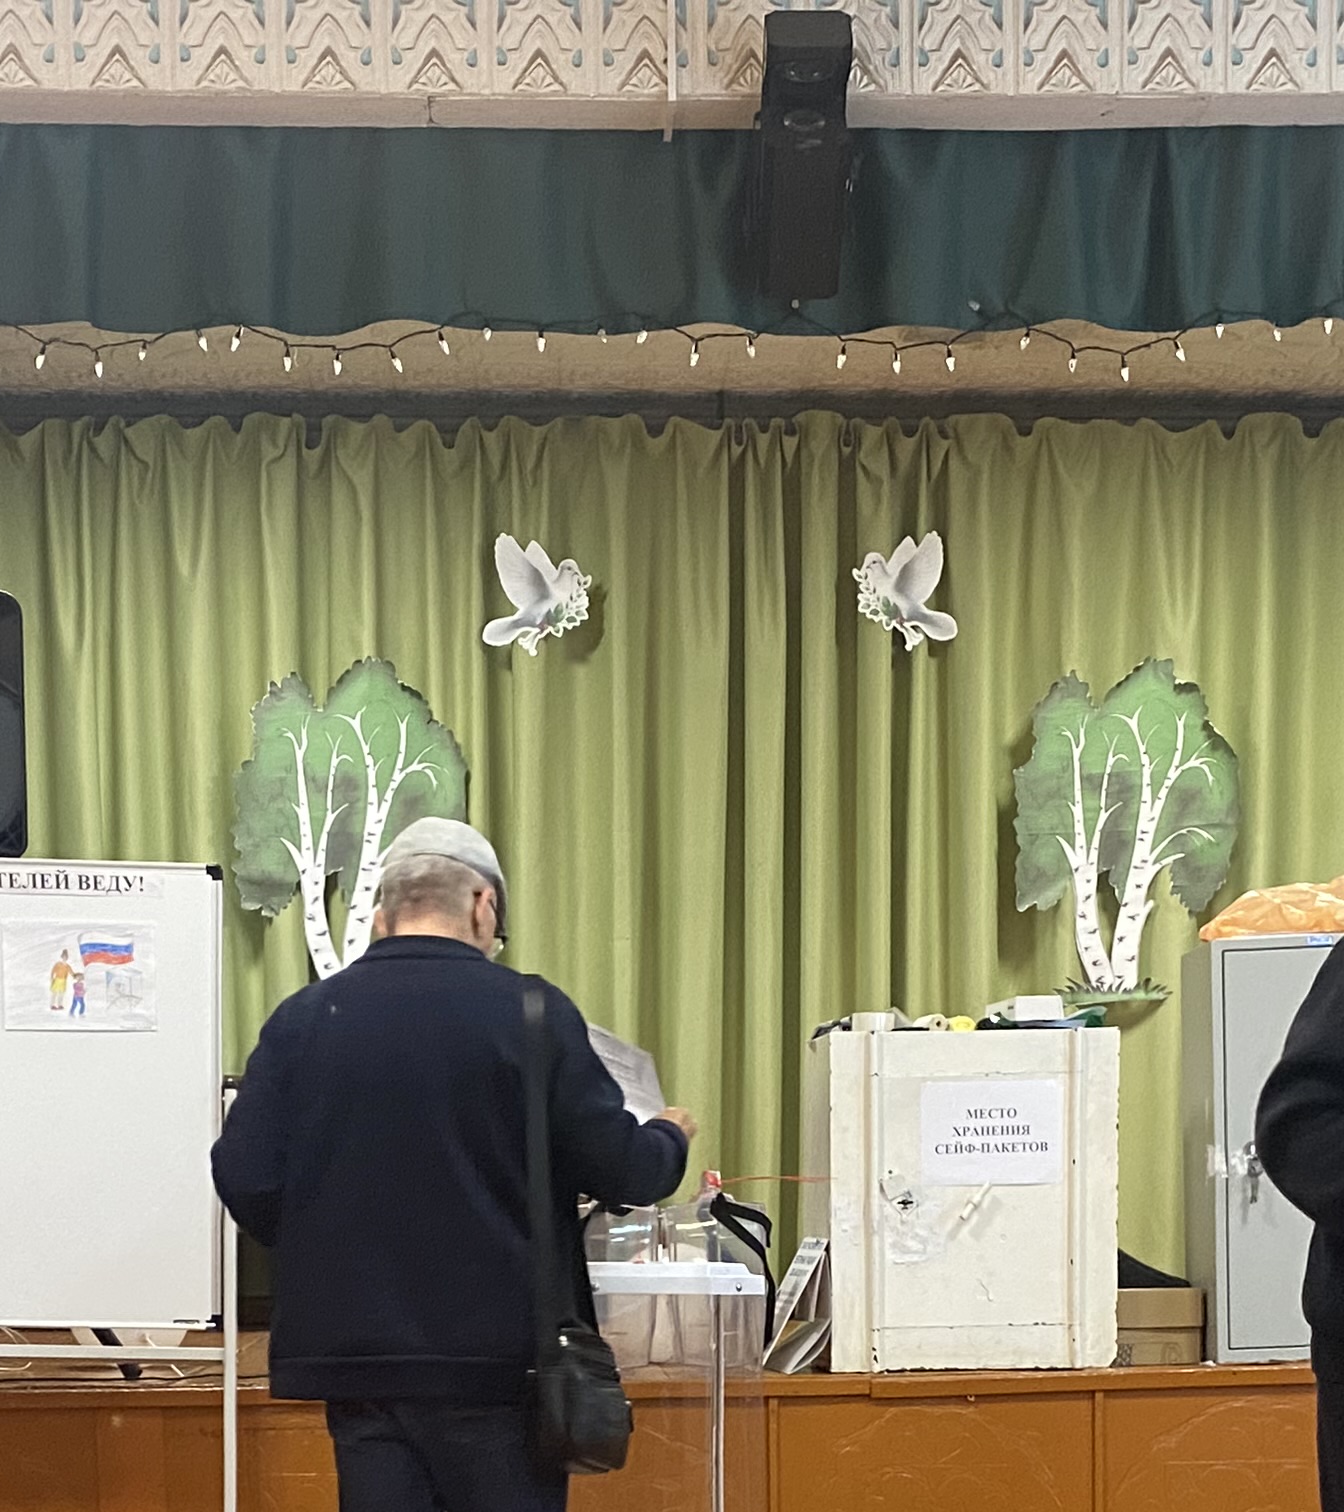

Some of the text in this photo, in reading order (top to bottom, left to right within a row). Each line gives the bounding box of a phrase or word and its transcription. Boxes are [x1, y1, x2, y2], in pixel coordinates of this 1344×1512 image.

[78, 874, 144, 894] ВЕДУ!
[966, 1108, 1017, 1119] МЕСТО
[952, 1124, 1031, 1137] ХРАНЕНИЯ
[934, 1141, 1049, 1155] СЕЙФ-ПАКЕТОВ
